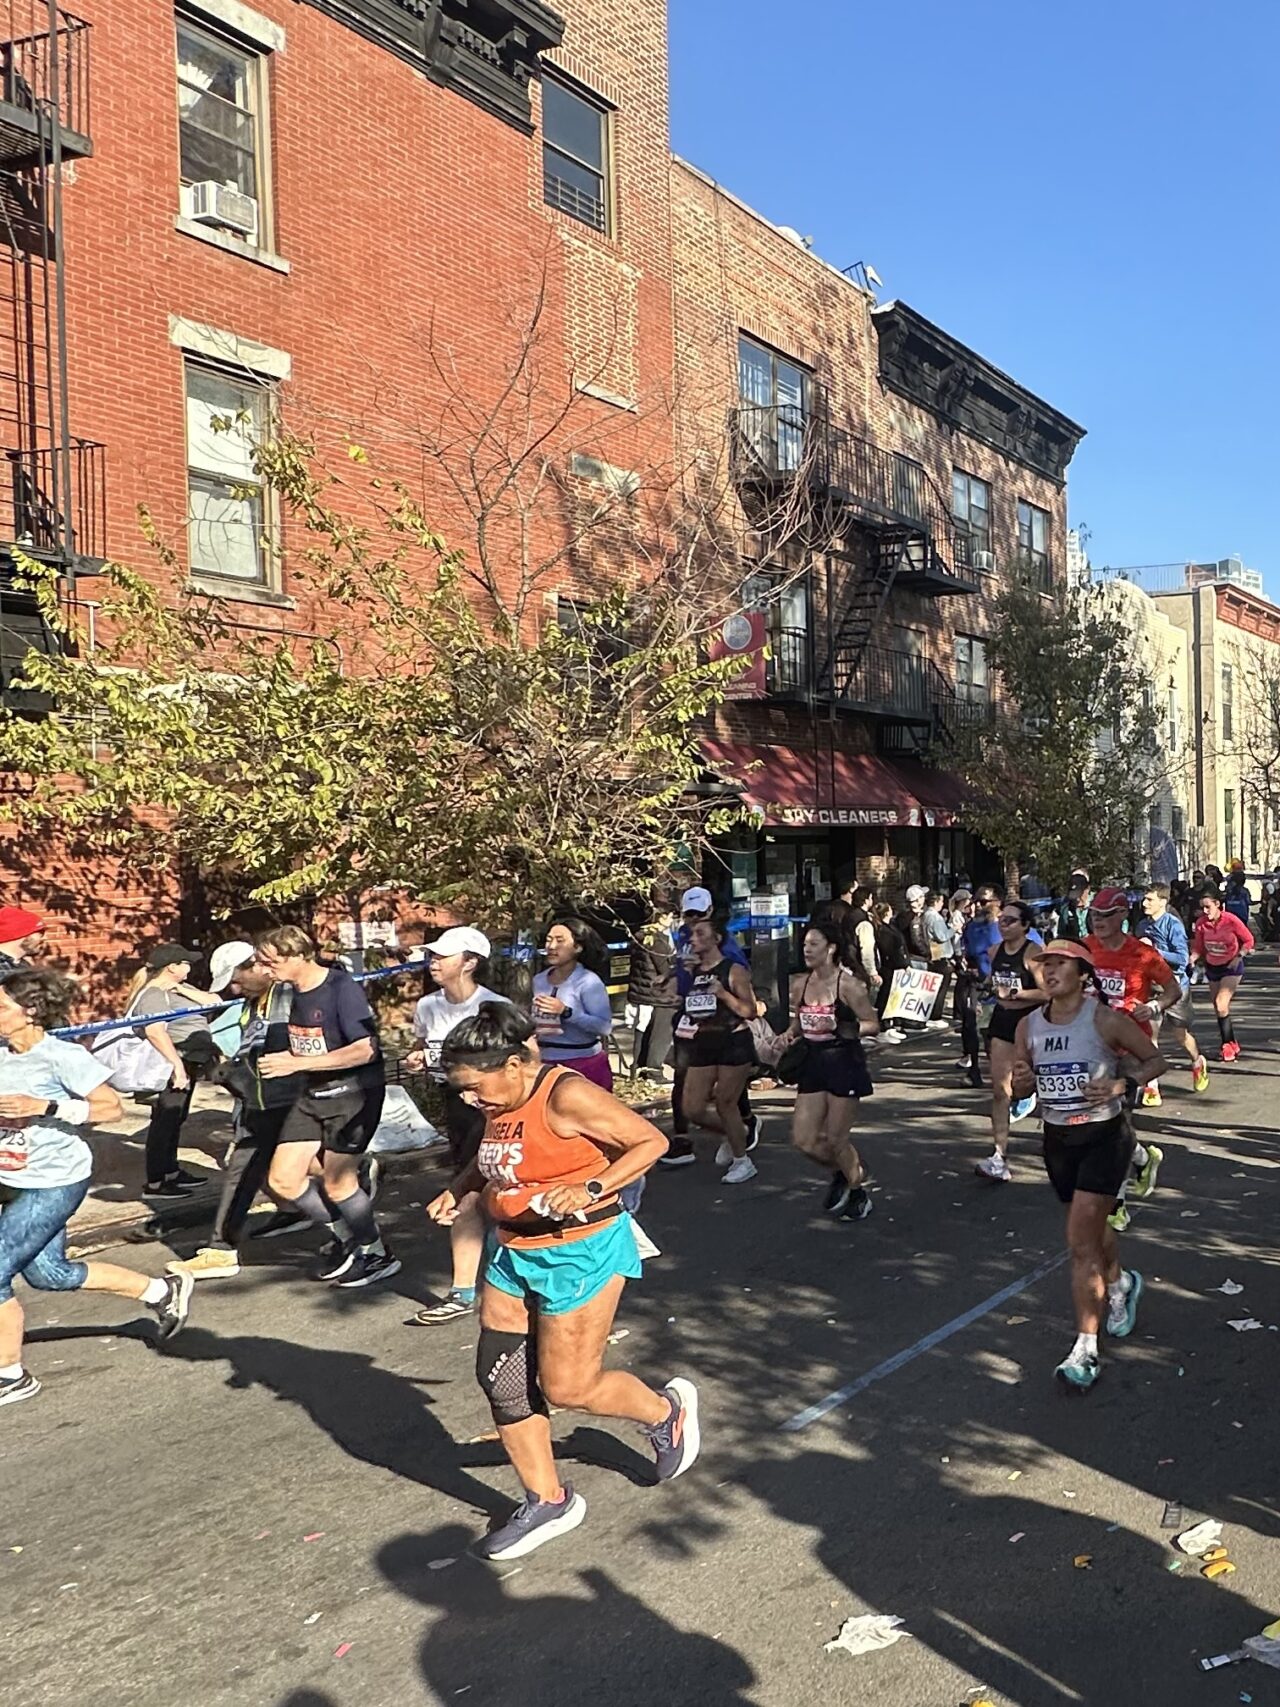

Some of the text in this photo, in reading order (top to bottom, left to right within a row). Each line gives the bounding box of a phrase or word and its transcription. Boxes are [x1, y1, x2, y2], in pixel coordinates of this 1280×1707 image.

[818, 809, 898, 824] CLEANERS
[900, 991, 931, 1018] FEIN
[1044, 1035, 1069, 1052] MAI
[1038, 1074, 1087, 1093] 53336
[0, 1128, 26, 1146] 723
